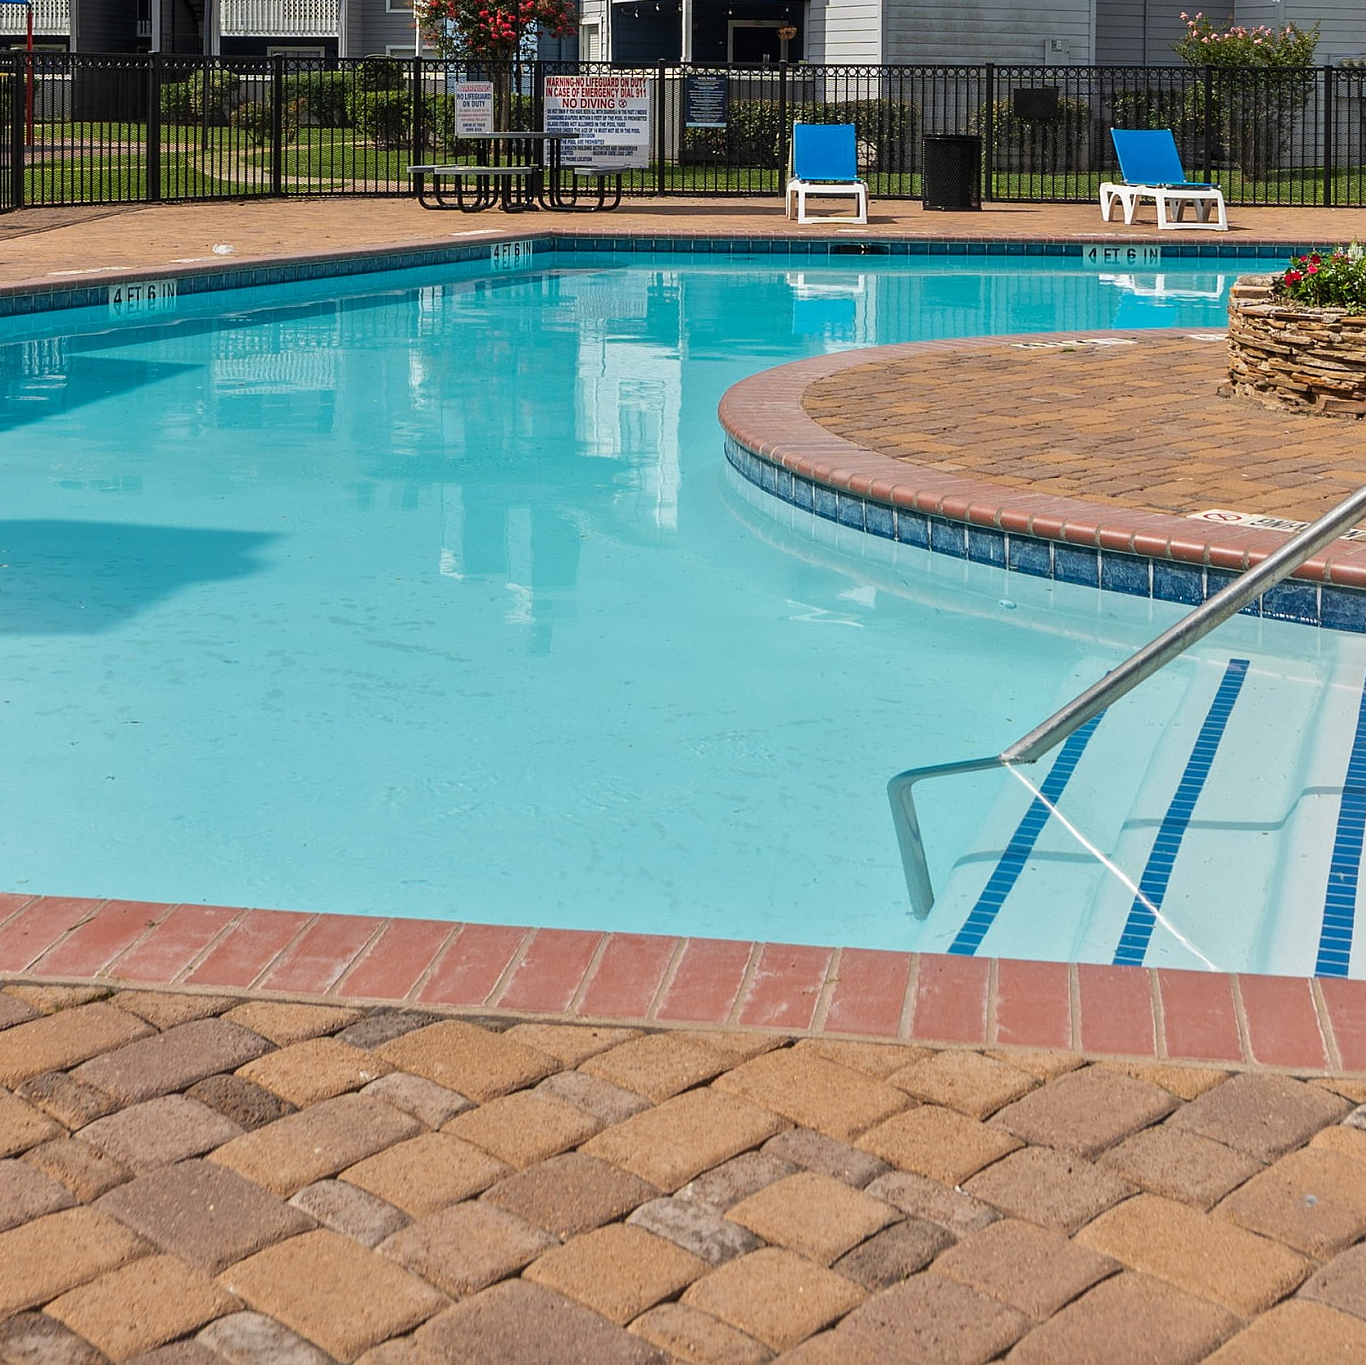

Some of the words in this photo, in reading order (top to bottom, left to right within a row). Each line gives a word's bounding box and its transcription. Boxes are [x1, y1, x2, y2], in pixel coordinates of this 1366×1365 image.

[586, 78, 619, 87] LIFEGUARD
[621, 78, 629, 87] ON
[631, 78, 647, 87] DUTY
[546, 88, 552, 97] IN
[554, 88, 570, 97] CASE
[572, 88, 579, 97] OF
[582, 88, 619, 97] EMERGENCY
[621, 88, 634, 97] DIAL
[636, 88, 647, 97] 911
[563, 99, 577, 108] NO
[581, 99, 615, 108] DIVING
[494, 244, 500, 256] 4
[515, 243, 520, 256] 6
[114, 288, 122, 303] 4
[127, 286, 142, 302] FT
[148, 285, 155, 300] 6
[162, 283, 175, 298] IN
